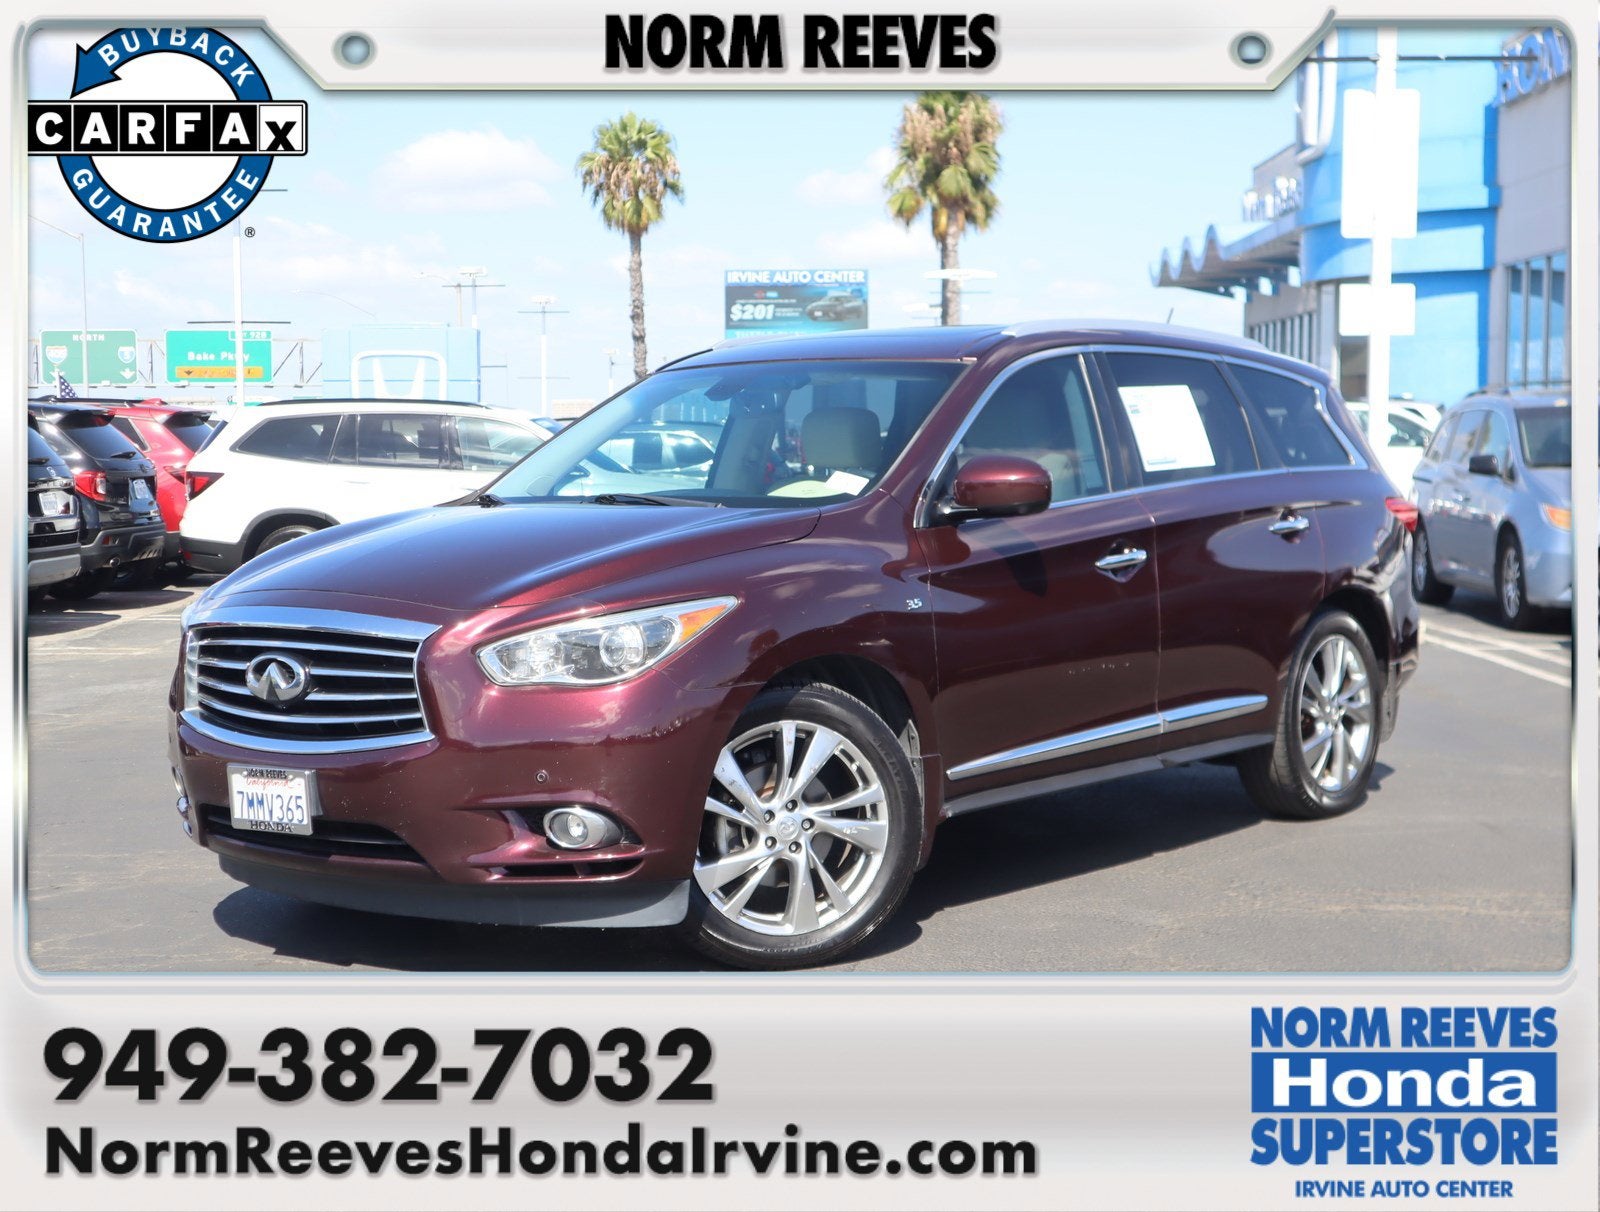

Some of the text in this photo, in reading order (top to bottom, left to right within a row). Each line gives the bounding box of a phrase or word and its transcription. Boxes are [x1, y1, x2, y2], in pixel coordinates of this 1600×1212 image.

[727, 271, 865, 284] IRVINE AUTO CENTER
[730, 303, 775, 321] $201
[72, 333, 105, 342] NORTH
[187, 351, 250, 362] Bake Pky
[236, 790, 304, 824] 7MMV365
[249, 820, 293, 833] HONDA
